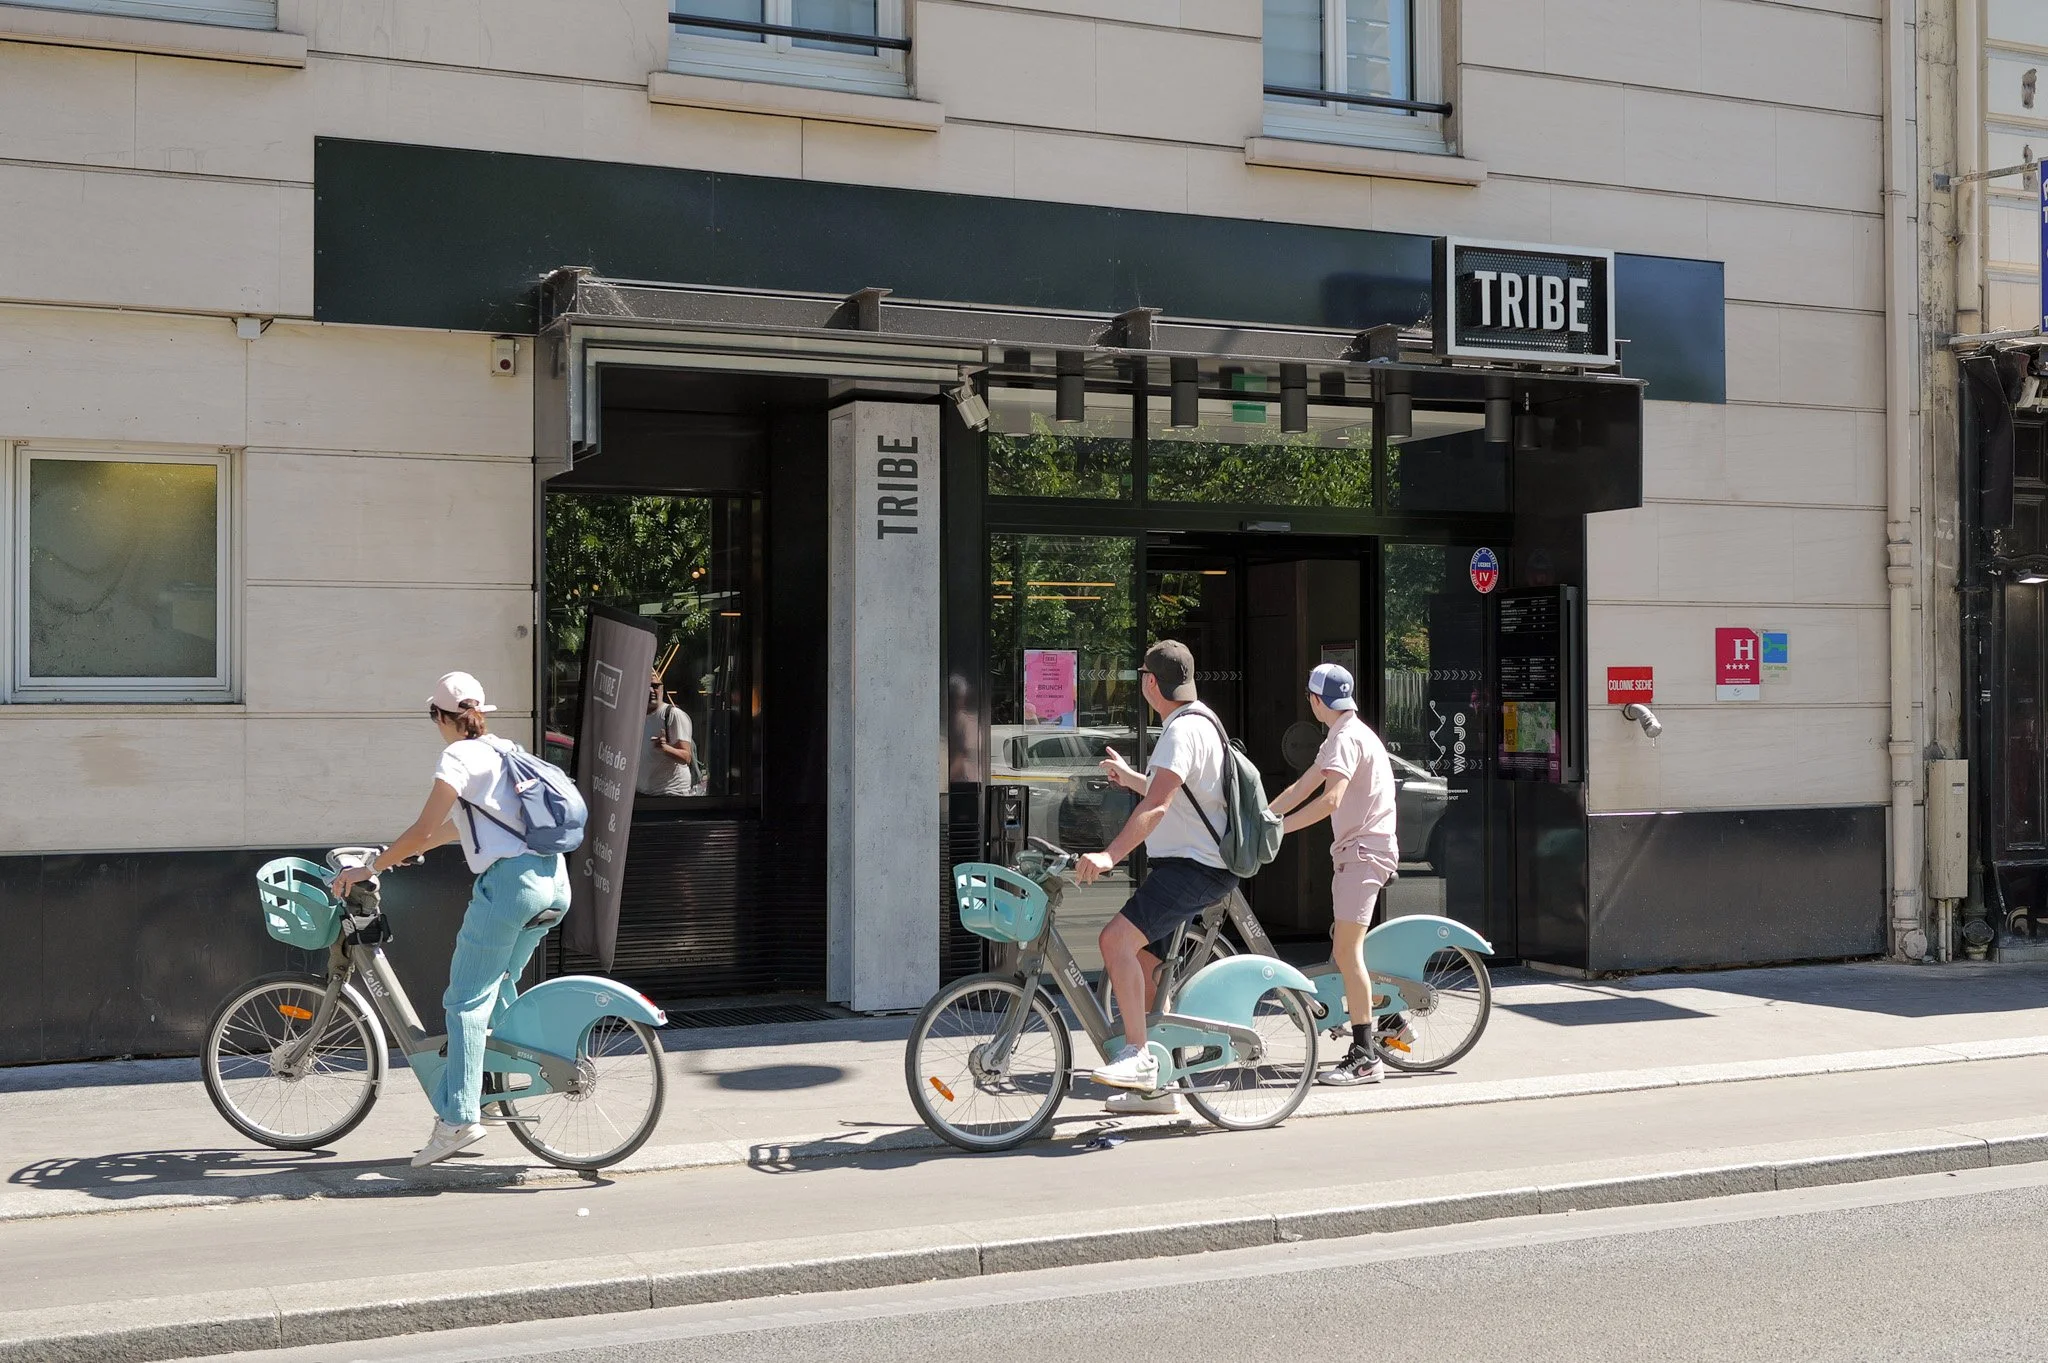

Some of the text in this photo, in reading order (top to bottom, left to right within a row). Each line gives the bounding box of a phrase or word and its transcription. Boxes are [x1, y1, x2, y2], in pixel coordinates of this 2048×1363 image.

[1474, 270, 1589, 333] TRIBE
[877, 435, 918, 540] TRIBE
[1479, 572, 1489, 582] IV
[1733, 638, 1756, 661] H
[1453, 712, 1467, 775] WOJO
[613, 749, 627, 771] de
[607, 813, 617, 833] &
